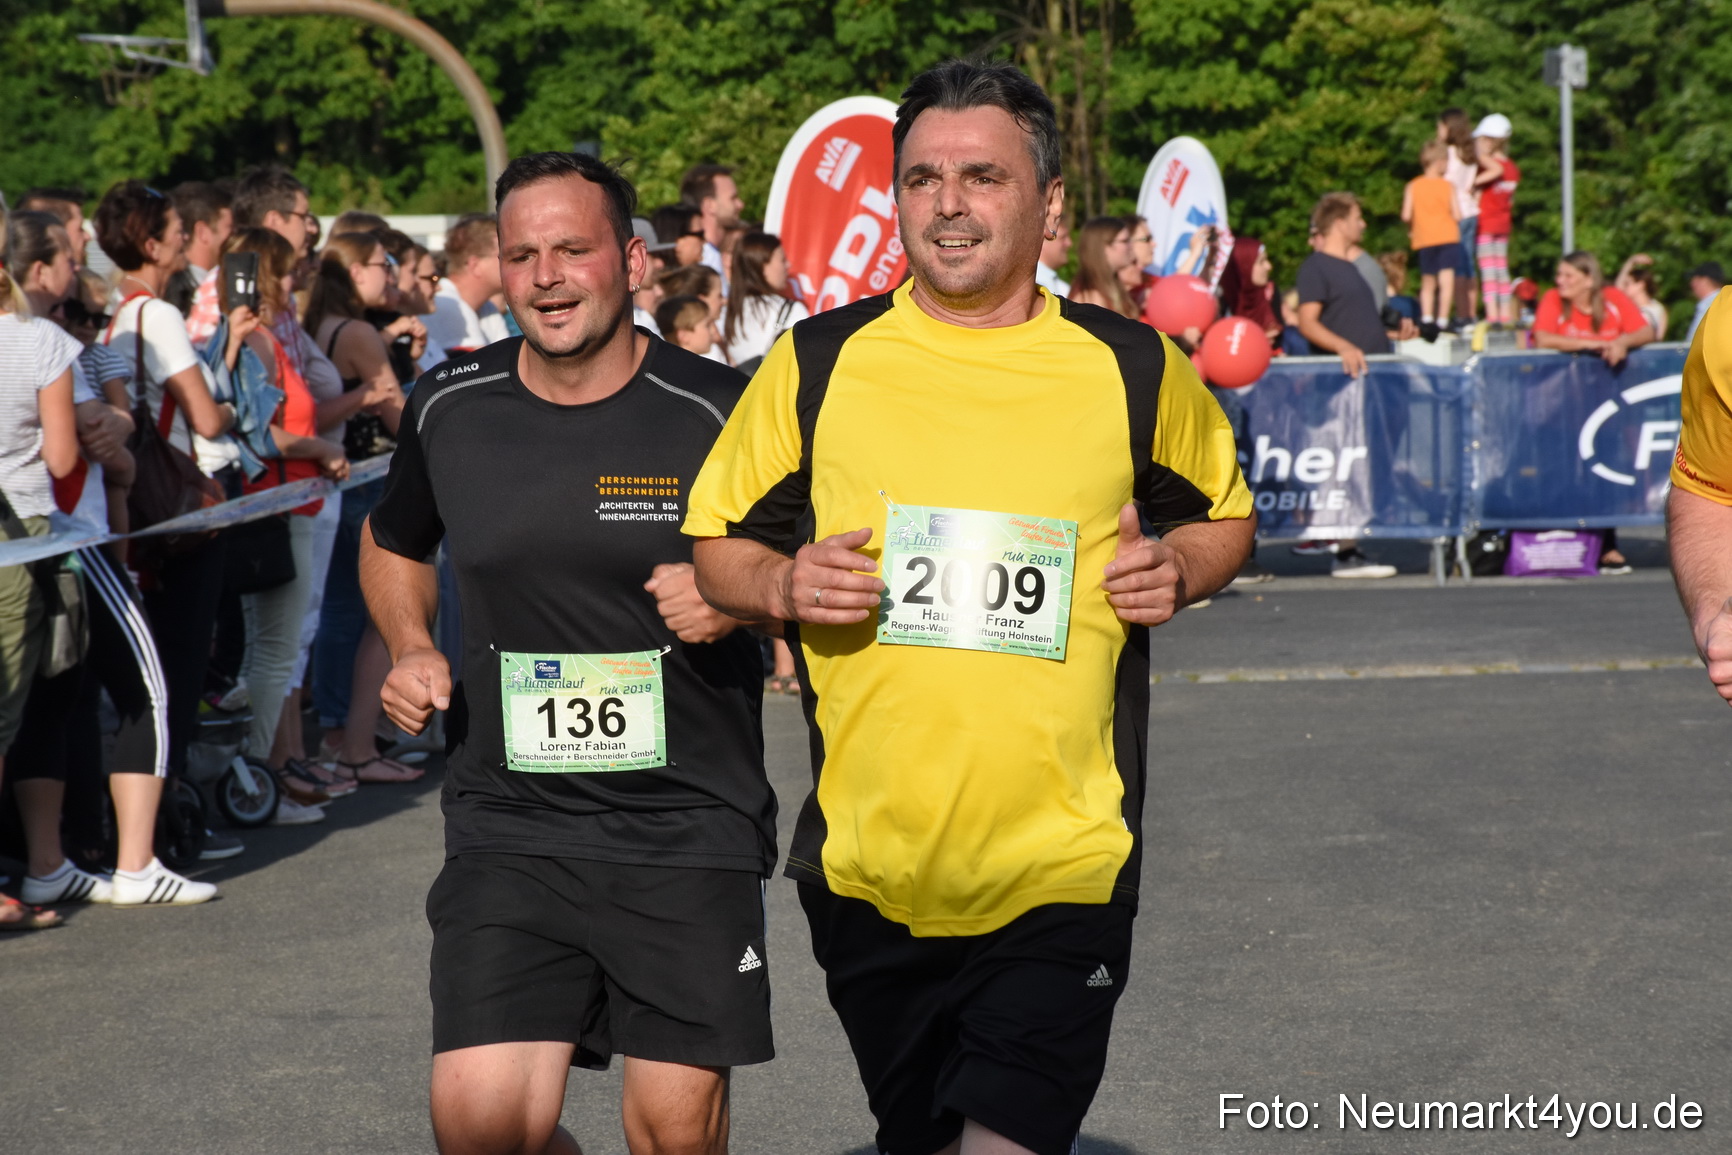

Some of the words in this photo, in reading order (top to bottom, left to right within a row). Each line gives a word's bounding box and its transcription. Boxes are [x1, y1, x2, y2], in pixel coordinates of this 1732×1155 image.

[815, 136, 850, 185] AVIA
[1159, 158, 1182, 199] AVIA
[450, 362, 480, 376] JAKO
[1634, 420, 1681, 470] F
[1237, 434, 1368, 483] her
[599, 476, 679, 485] BERSCHNEIDER
[599, 487, 679, 496] BERSCHNEIDER
[599, 502, 655, 510] ARCHITEKTEN
[662, 502, 679, 511] BDA
[1254, 489, 1347, 512] OBILE
[599, 513, 679, 522] INNENARCHITEKTEN
[1029, 553, 1062, 567] 2019
[902, 556, 1046, 615] 2009
[985, 613, 1025, 629] Franz
[1008, 628, 1053, 644] Holnstein
[524, 677, 585, 689] firmenlauf
[623, 683, 652, 695] 2019
[537, 697, 627, 739] 136
[540, 741, 581, 751] Lorenz
[585, 741, 626, 751] Fabian
[513, 752, 564, 761] Berschneider
[573, 752, 629, 761] Berschneider
[630, 749, 656, 759] GmbH
[738, 959, 762, 972] adidas
[1086, 977, 1113, 987] adidas
